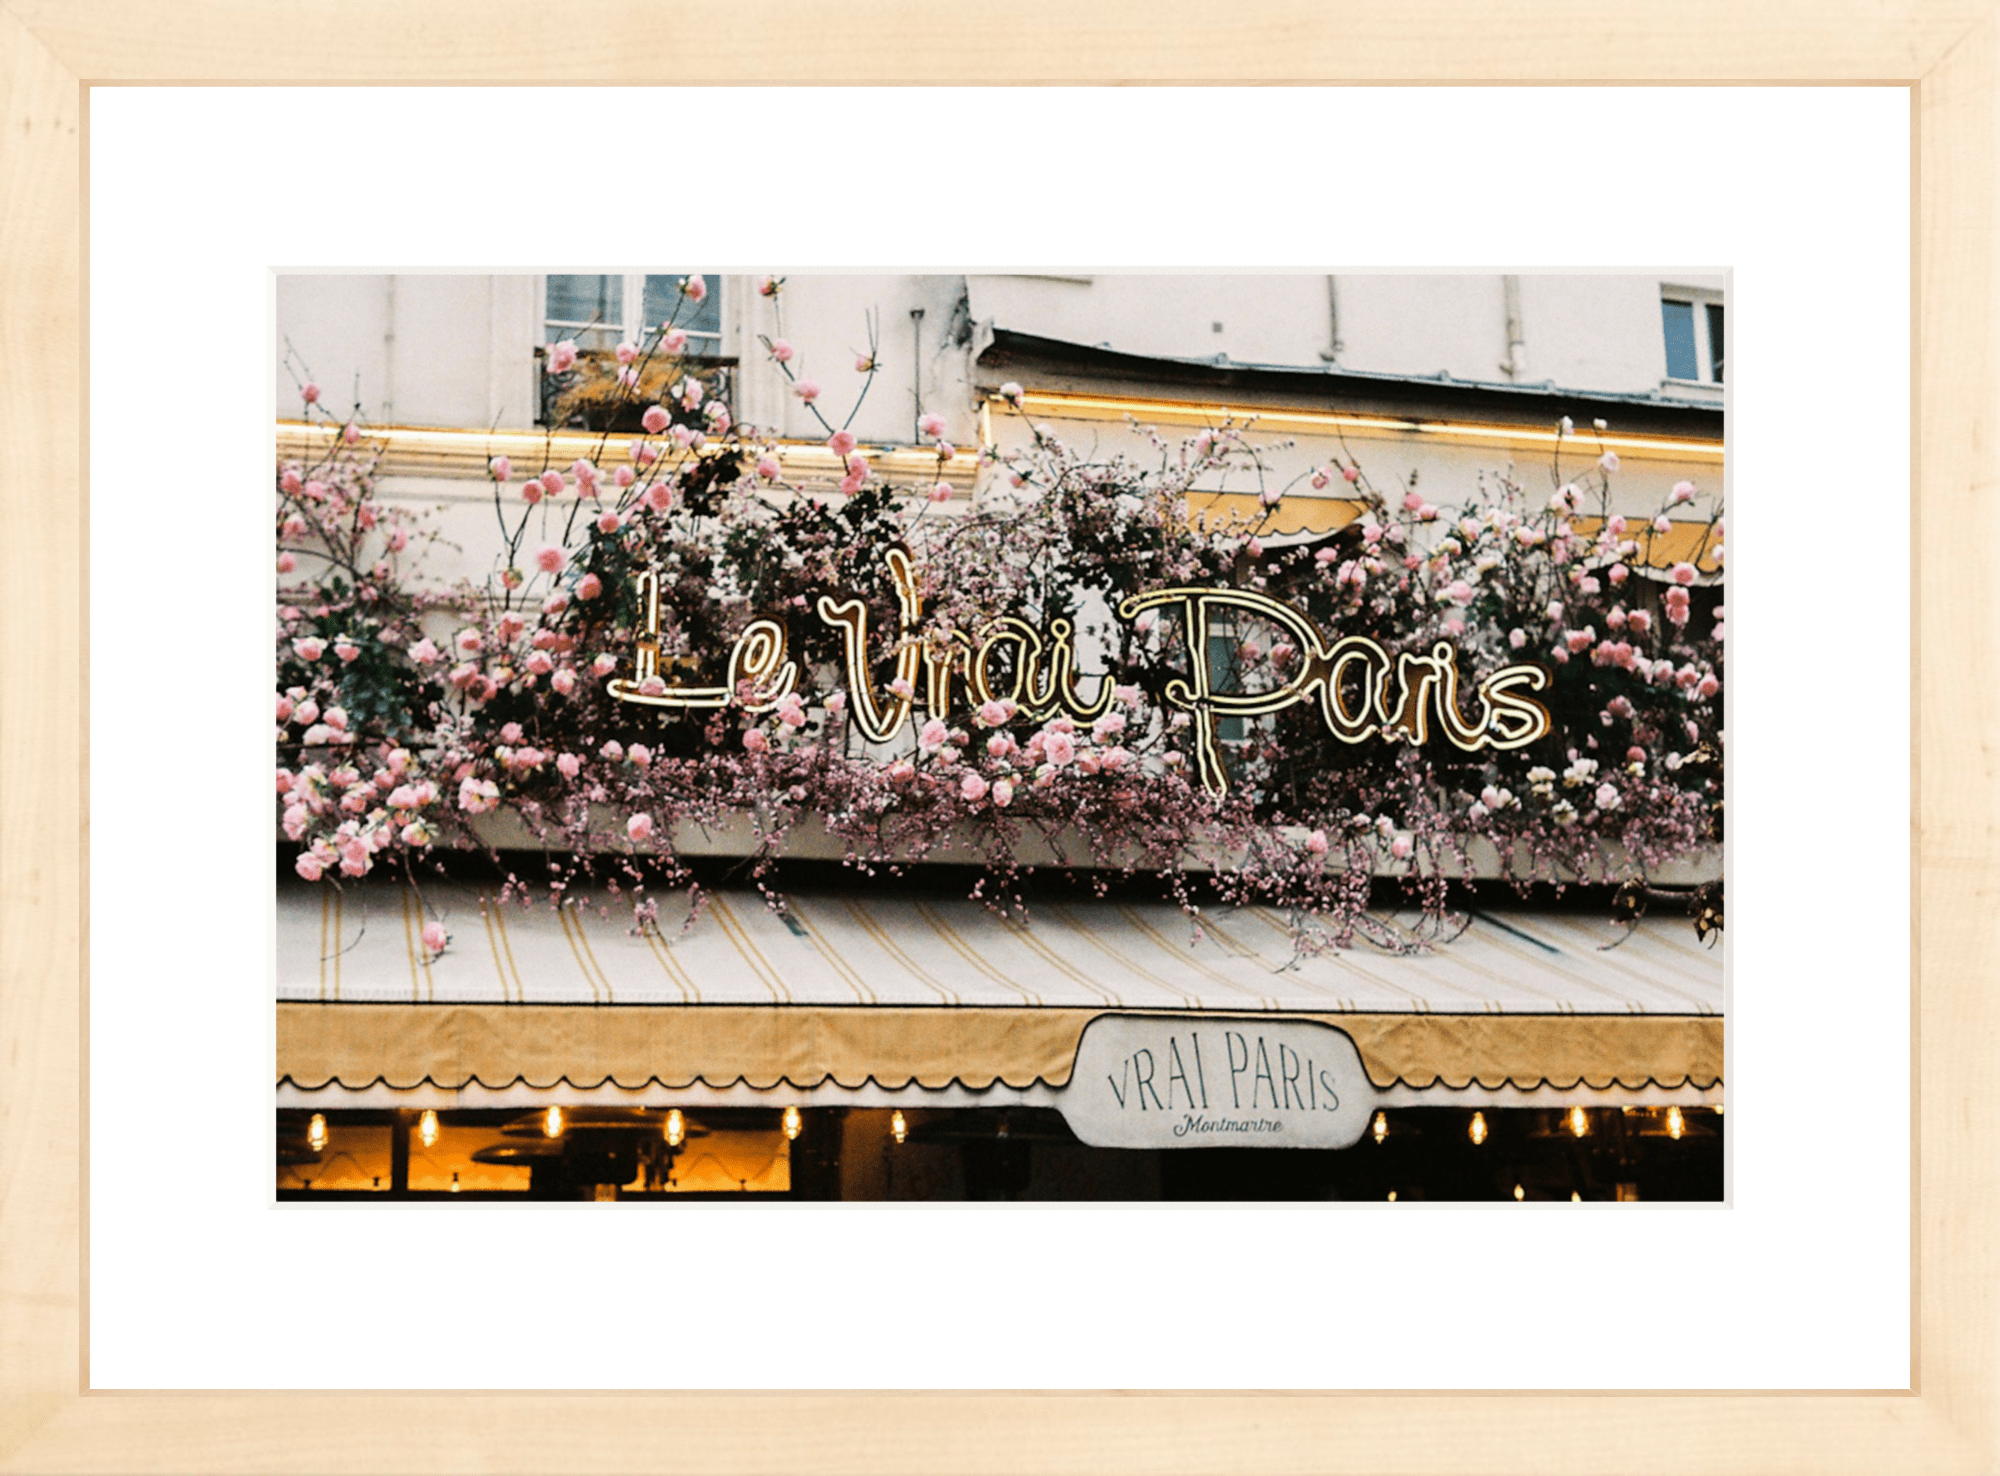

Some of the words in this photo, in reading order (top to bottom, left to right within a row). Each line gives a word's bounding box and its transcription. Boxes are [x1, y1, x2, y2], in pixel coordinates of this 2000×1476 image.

[606, 570, 799, 713] Le
[817, 546, 1118, 745] Vrai
[1119, 585, 1552, 800] Paris
[1107, 1032, 1210, 1111] VRAI
[1225, 1031, 1340, 1112] PARIS
[1172, 1112, 1284, 1138] Montmartre
